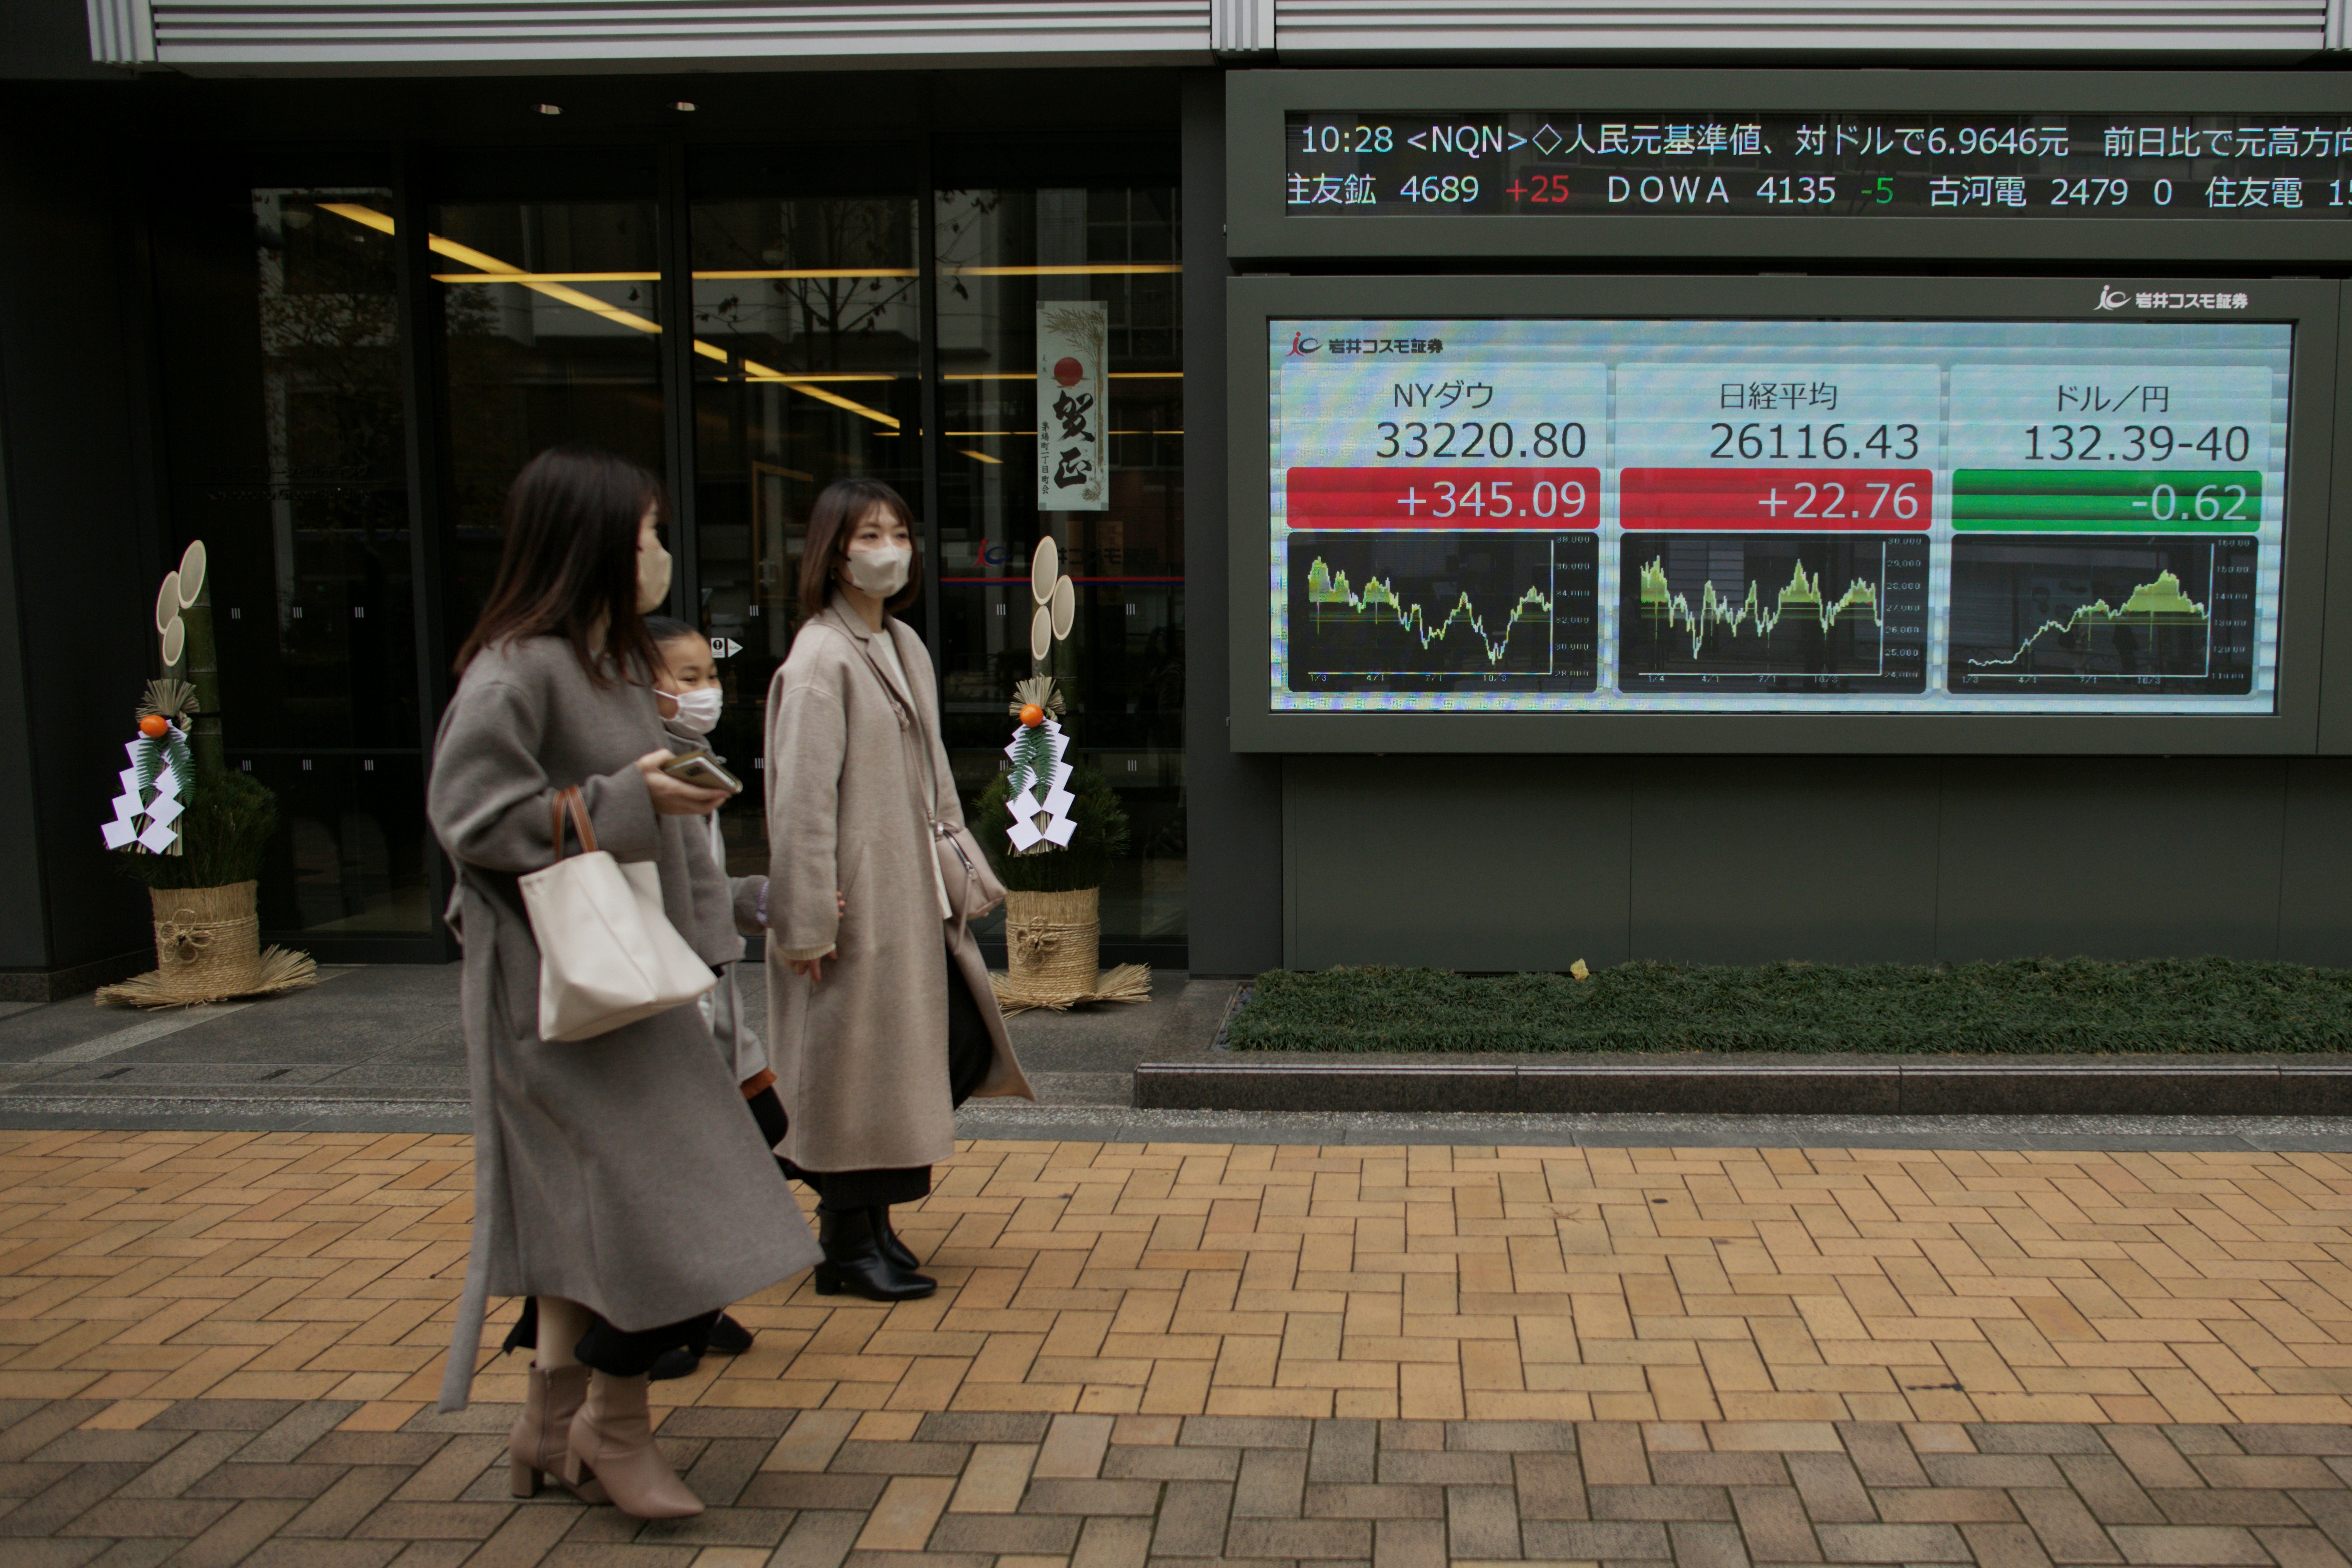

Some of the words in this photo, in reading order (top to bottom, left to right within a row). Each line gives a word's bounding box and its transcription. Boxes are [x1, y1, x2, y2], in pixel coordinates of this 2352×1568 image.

[1302, 125, 1393, 153] 10:28
[1400, 175, 1479, 203] 4689
[1506, 175, 1569, 203] +25
[1608, 176, 1729, 203] DOWA
[1756, 176, 1836, 204] 4135
[1861, 177, 1894, 204] -5
[1929, 175, 2027, 207] 古河電
[2050, 178, 2128, 206] 2479
[2153, 179, 2172, 206] 0
[2205, 176, 2303, 208] 住友電
[2135, 292, 2248, 309] 岩井コスモ証券
[1329, 338, 1444, 354] 岩井コスモ証券
[1394, 380, 1493, 409] NYダウ
[1720, 381, 1837, 411] 日経平均
[1052, 390, 1095, 489] 賀正
[1376, 421, 1586, 459] 33220.80
[1710, 423, 1918, 460] 26116.43
[2025, 425, 2250, 462] 132.39-40
[1397, 481, 1586, 518] +345.09
[1758, 482, 1918, 519] +22.76
[2132, 484, 2246, 520] -0.62
